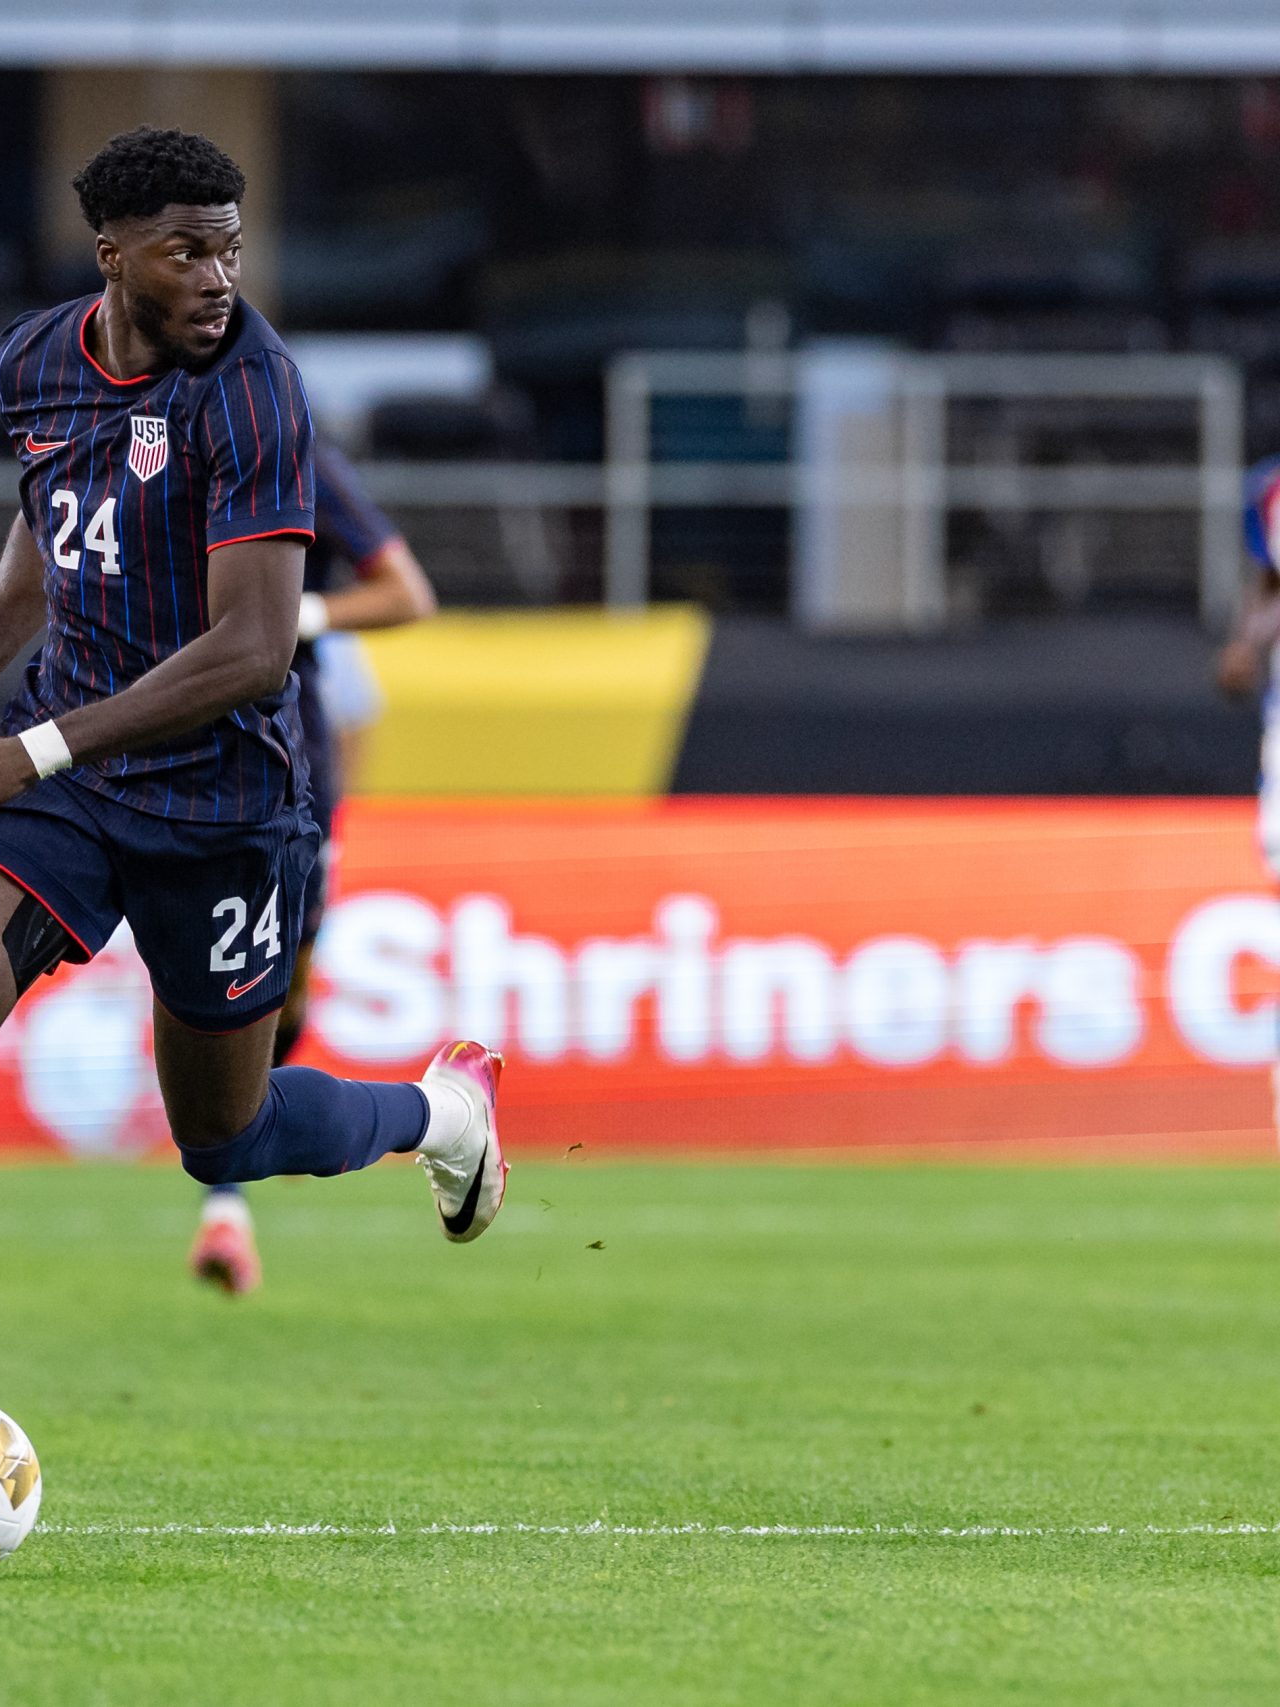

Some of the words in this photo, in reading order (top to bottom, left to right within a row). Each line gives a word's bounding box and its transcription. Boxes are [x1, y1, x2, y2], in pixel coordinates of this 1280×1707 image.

[134, 419, 166, 445] USA
[51, 489, 121, 575] 24
[209, 883, 281, 972] 24
[310, 890, 1148, 1068] Shriners
